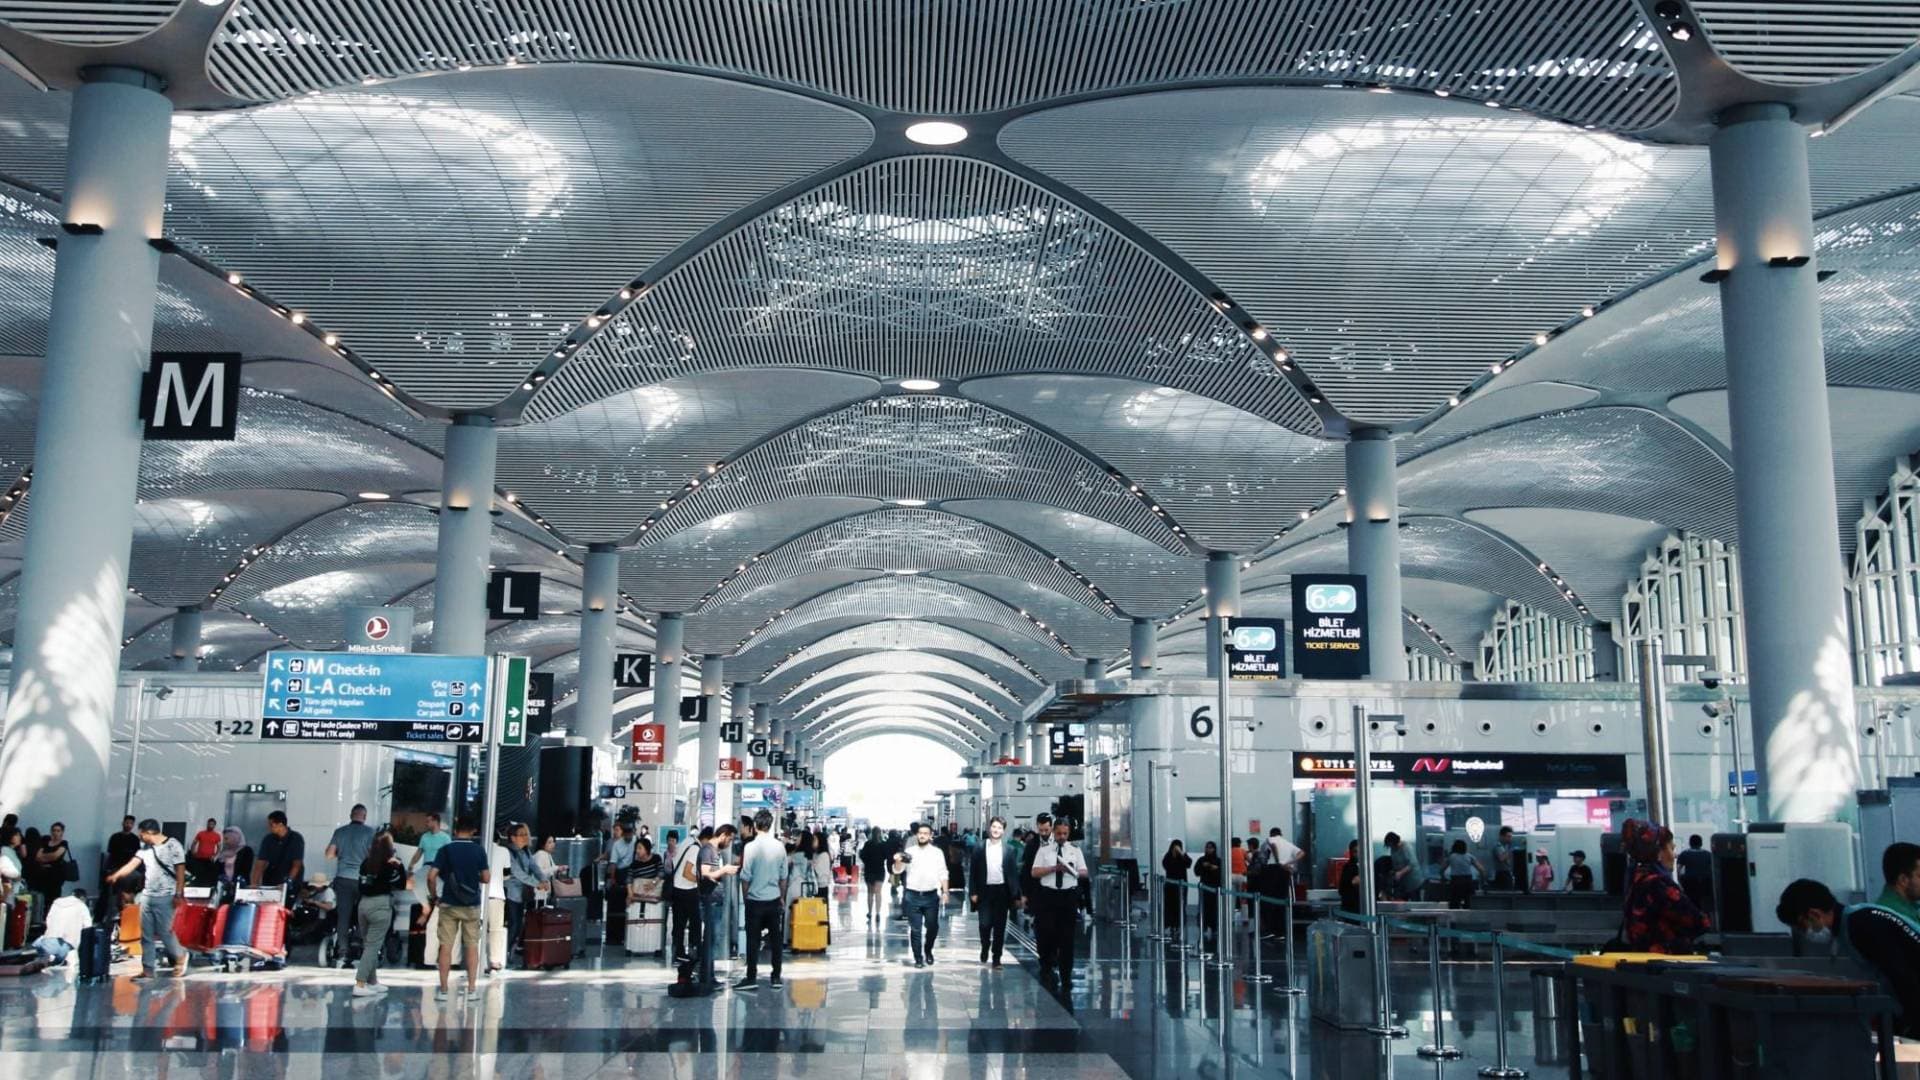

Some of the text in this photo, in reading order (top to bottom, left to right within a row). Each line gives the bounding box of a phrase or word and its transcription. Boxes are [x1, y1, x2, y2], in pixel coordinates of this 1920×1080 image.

[152, 362, 224, 427] M
[503, 577, 525, 613] L
[1311, 588, 1325, 609] 6
[1319, 617, 1345, 628] BİLET
[1240, 630, 1250, 648] 6
[1303, 628, 1360, 638] HİZMETLERİ
[348, 644, 405, 653] Miles&Smiles
[1305, 642, 1360, 650] TICKET SERVICES
[1244, 654, 1266, 663] BİLET
[307, 659, 381, 676] M Check-in
[622, 658, 643, 684] K
[305, 679, 392, 696] L-A Check-in
[690, 699, 700, 719] J
[214, 720, 254, 735] 1-22
[302, 721, 320, 730] Vergi
[412, 722, 428, 730] Bilet
[1190, 705, 1214, 738] 6
[301, 730, 312, 738] Tax
[406, 732, 444, 740] Ticket sales
[725, 724, 739, 741] H
[752, 741, 764, 755] G
[772, 752, 780, 765] F
[786, 761, 794, 773] E
[797, 768, 805, 778] D
[629, 772, 643, 790] K
[1016, 777, 1026, 791] 5
